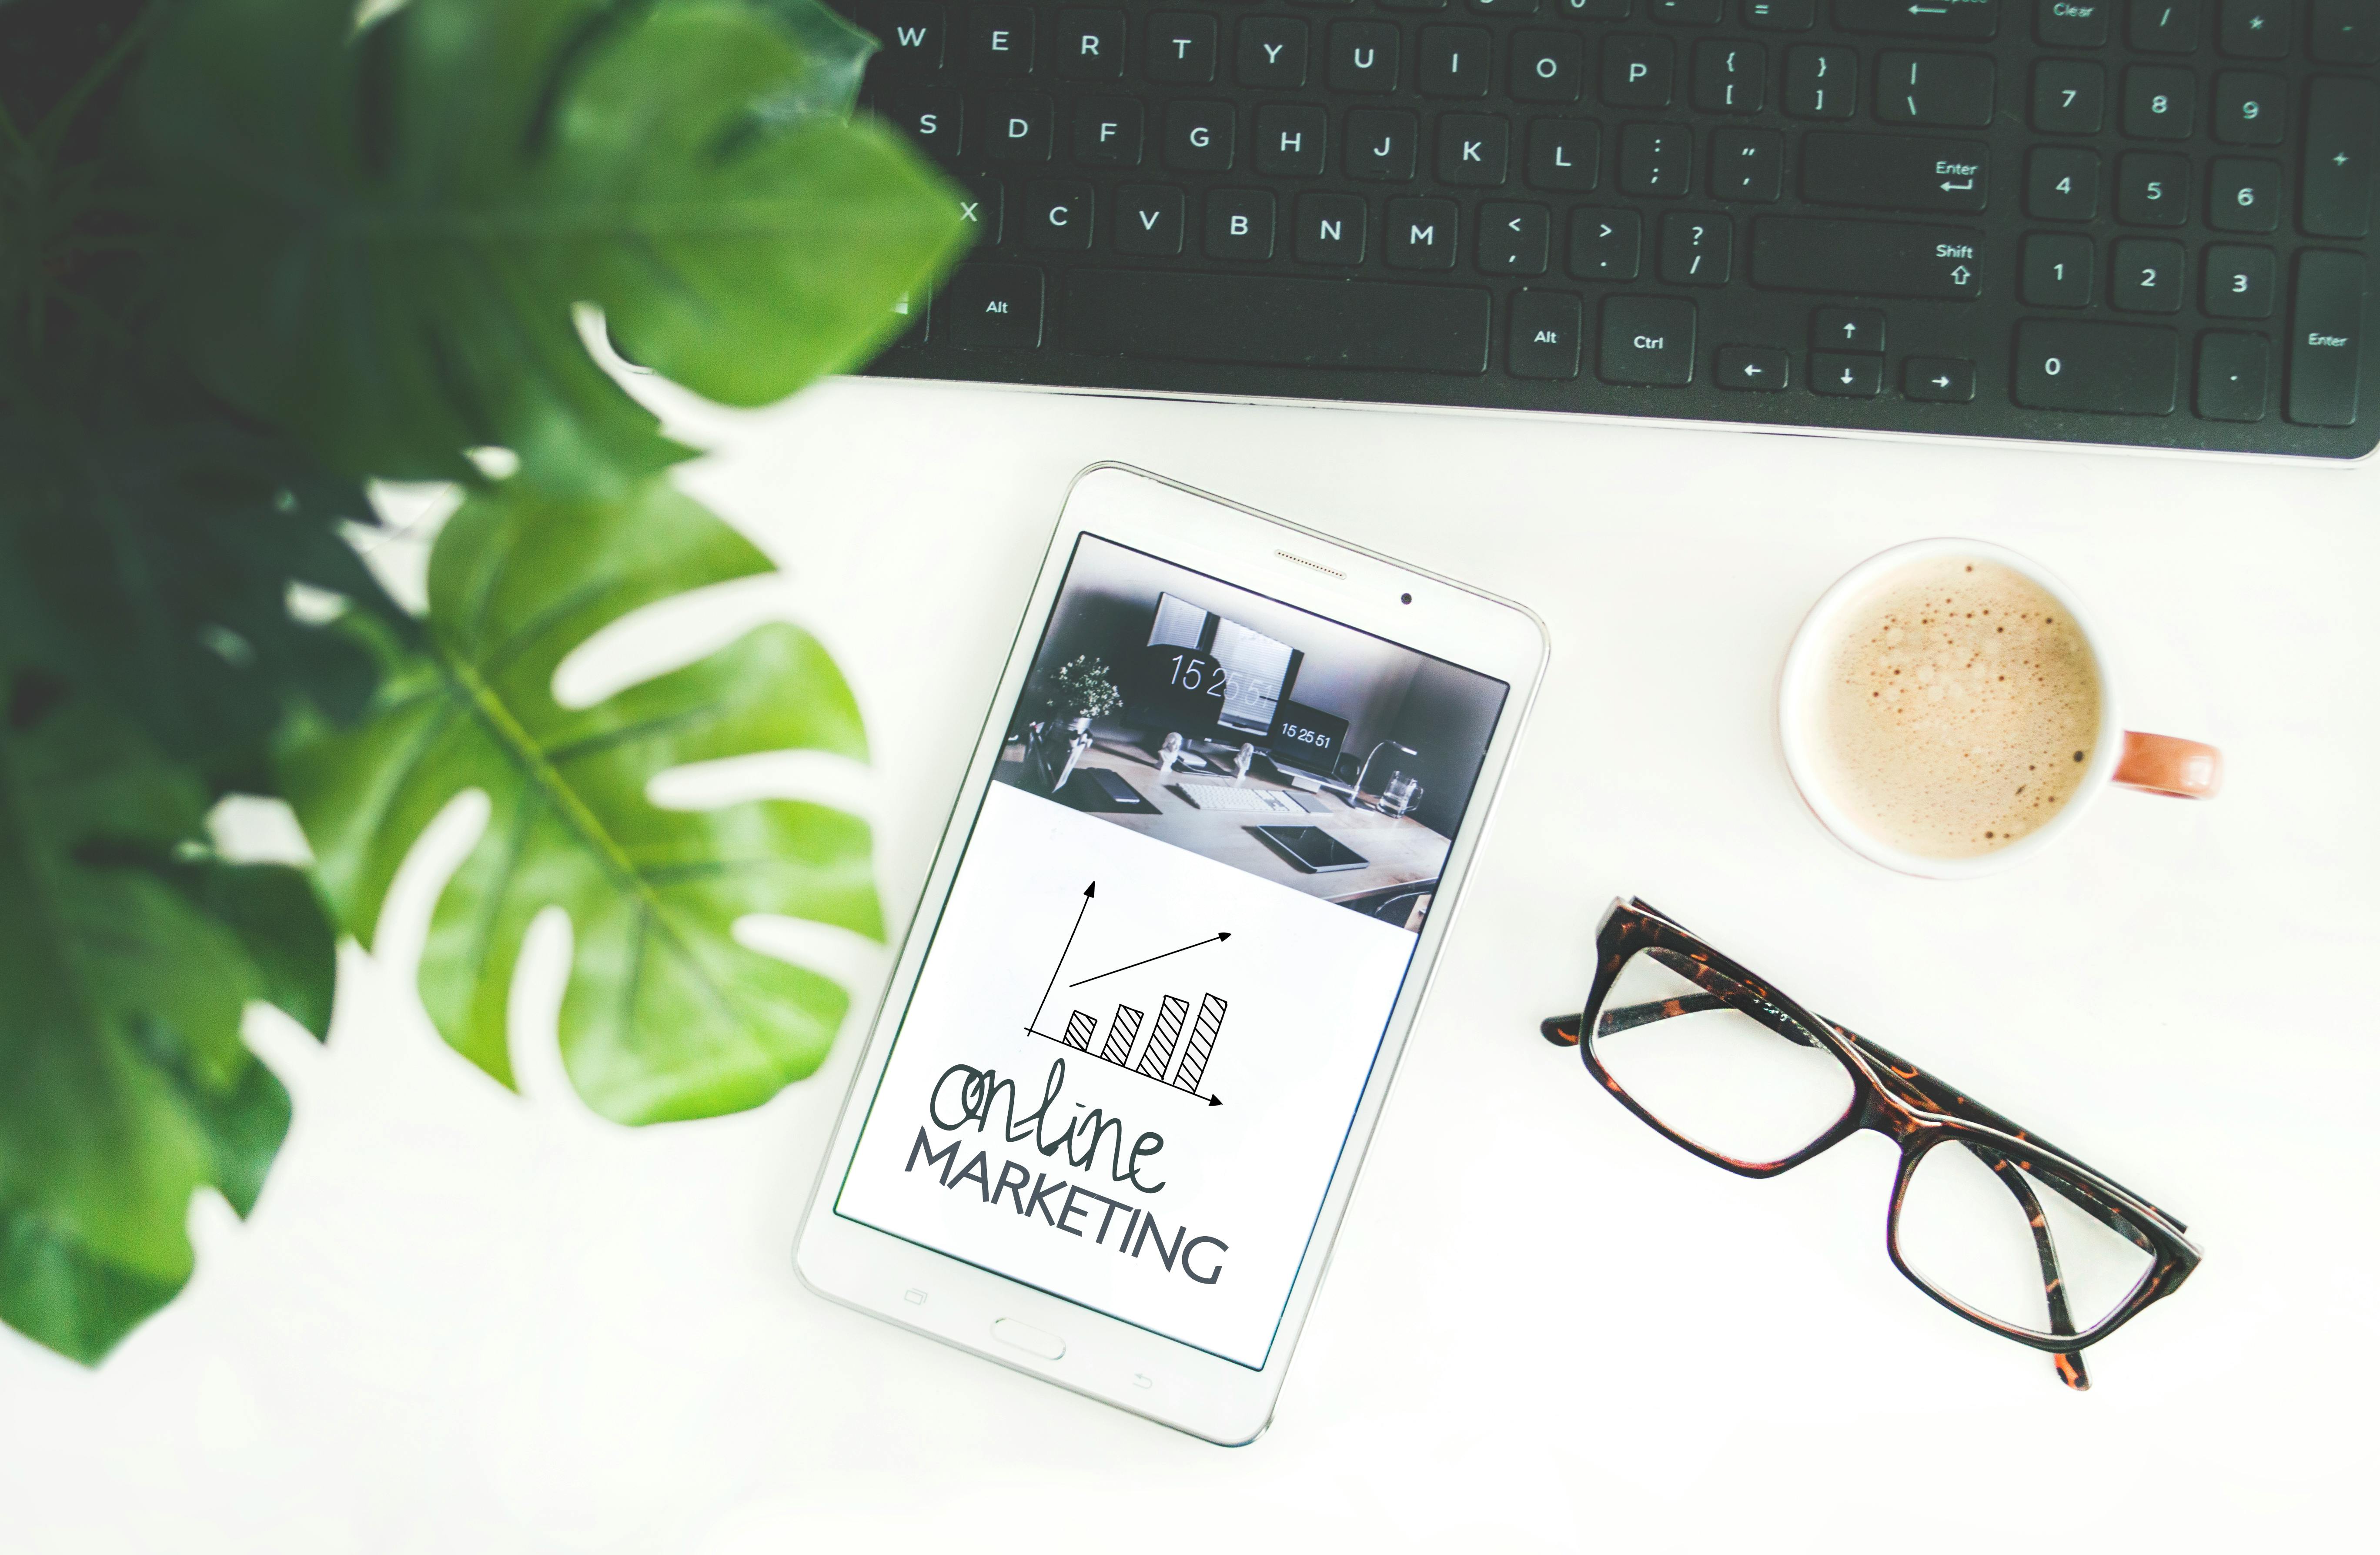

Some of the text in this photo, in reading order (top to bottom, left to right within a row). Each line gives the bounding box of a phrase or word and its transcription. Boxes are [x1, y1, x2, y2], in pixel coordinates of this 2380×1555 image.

[1755, 4, 1768, 14] =
[2053, 2, 2095, 17] Clear
[2160, 8, 2170, 26] /
[897, 27, 926, 47] W
[992, 31, 1009, 50] E
[1081, 35, 1099, 55] R
[1172, 39, 1192, 59] T
[1264, 43, 1283, 64] Y
[1354, 48, 1374, 68] U
[1452, 53, 1458, 73] I
[1536, 58, 1557, 78] O
[1726, 52, 1735, 72] {
[1818, 57, 1826, 77] }
[1629, 63, 1647, 82] P
[1726, 84, 1733, 105] [
[1815, 90, 1823, 110] ]
[2062, 90, 2076, 107] 7
[1907, 96, 1916, 115] \
[2152, 95, 2167, 114] 8
[2243, 101, 2259, 119] 9
[920, 114, 936, 134] S
[1009, 118, 1028, 138] D
[1100, 123, 1117, 142] F
[1190, 127, 1209, 147] G
[1281, 132, 1301, 152] H
[1374, 137, 1390, 156] J
[1463, 141, 1481, 161] K
[1556, 146, 1571, 167] L
[2333, 152, 2349, 166] +
[1936, 161, 1978, 175] Enter
[2056, 177, 2070, 194] 4
[2147, 182, 2161, 200] 5
[2238, 188, 2254, 206] 6
[959, 202, 979, 222] X
[1049, 206, 1068, 226] C
[1139, 211, 1160, 230] V
[1230, 215, 1248, 235] B
[1320, 220, 1341, 241] N
[1508, 218, 1521, 231] <
[1599, 224, 1612, 237] >
[1411, 225, 1433, 245] M
[1692, 226, 1703, 245] ?
[1936, 244, 1973, 259] Shift
[1690, 255, 1701, 274] /
[2054, 264, 2063, 281] 1
[2140, 268, 2156, 287] 2
[2232, 274, 2247, 292] 3
[986, 301, 1008, 314] Alt
[1534, 331, 1557, 344] Alt
[1634, 335, 1663, 349] Ctrl
[2308, 333, 2347, 347] Enter
[2045, 358, 2061, 375] 0
[1171, 655, 1272, 708] 15 25 51
[1282, 723, 1330, 748] 15 25 51
[904, 1125, 1229, 1284] MARKETING
